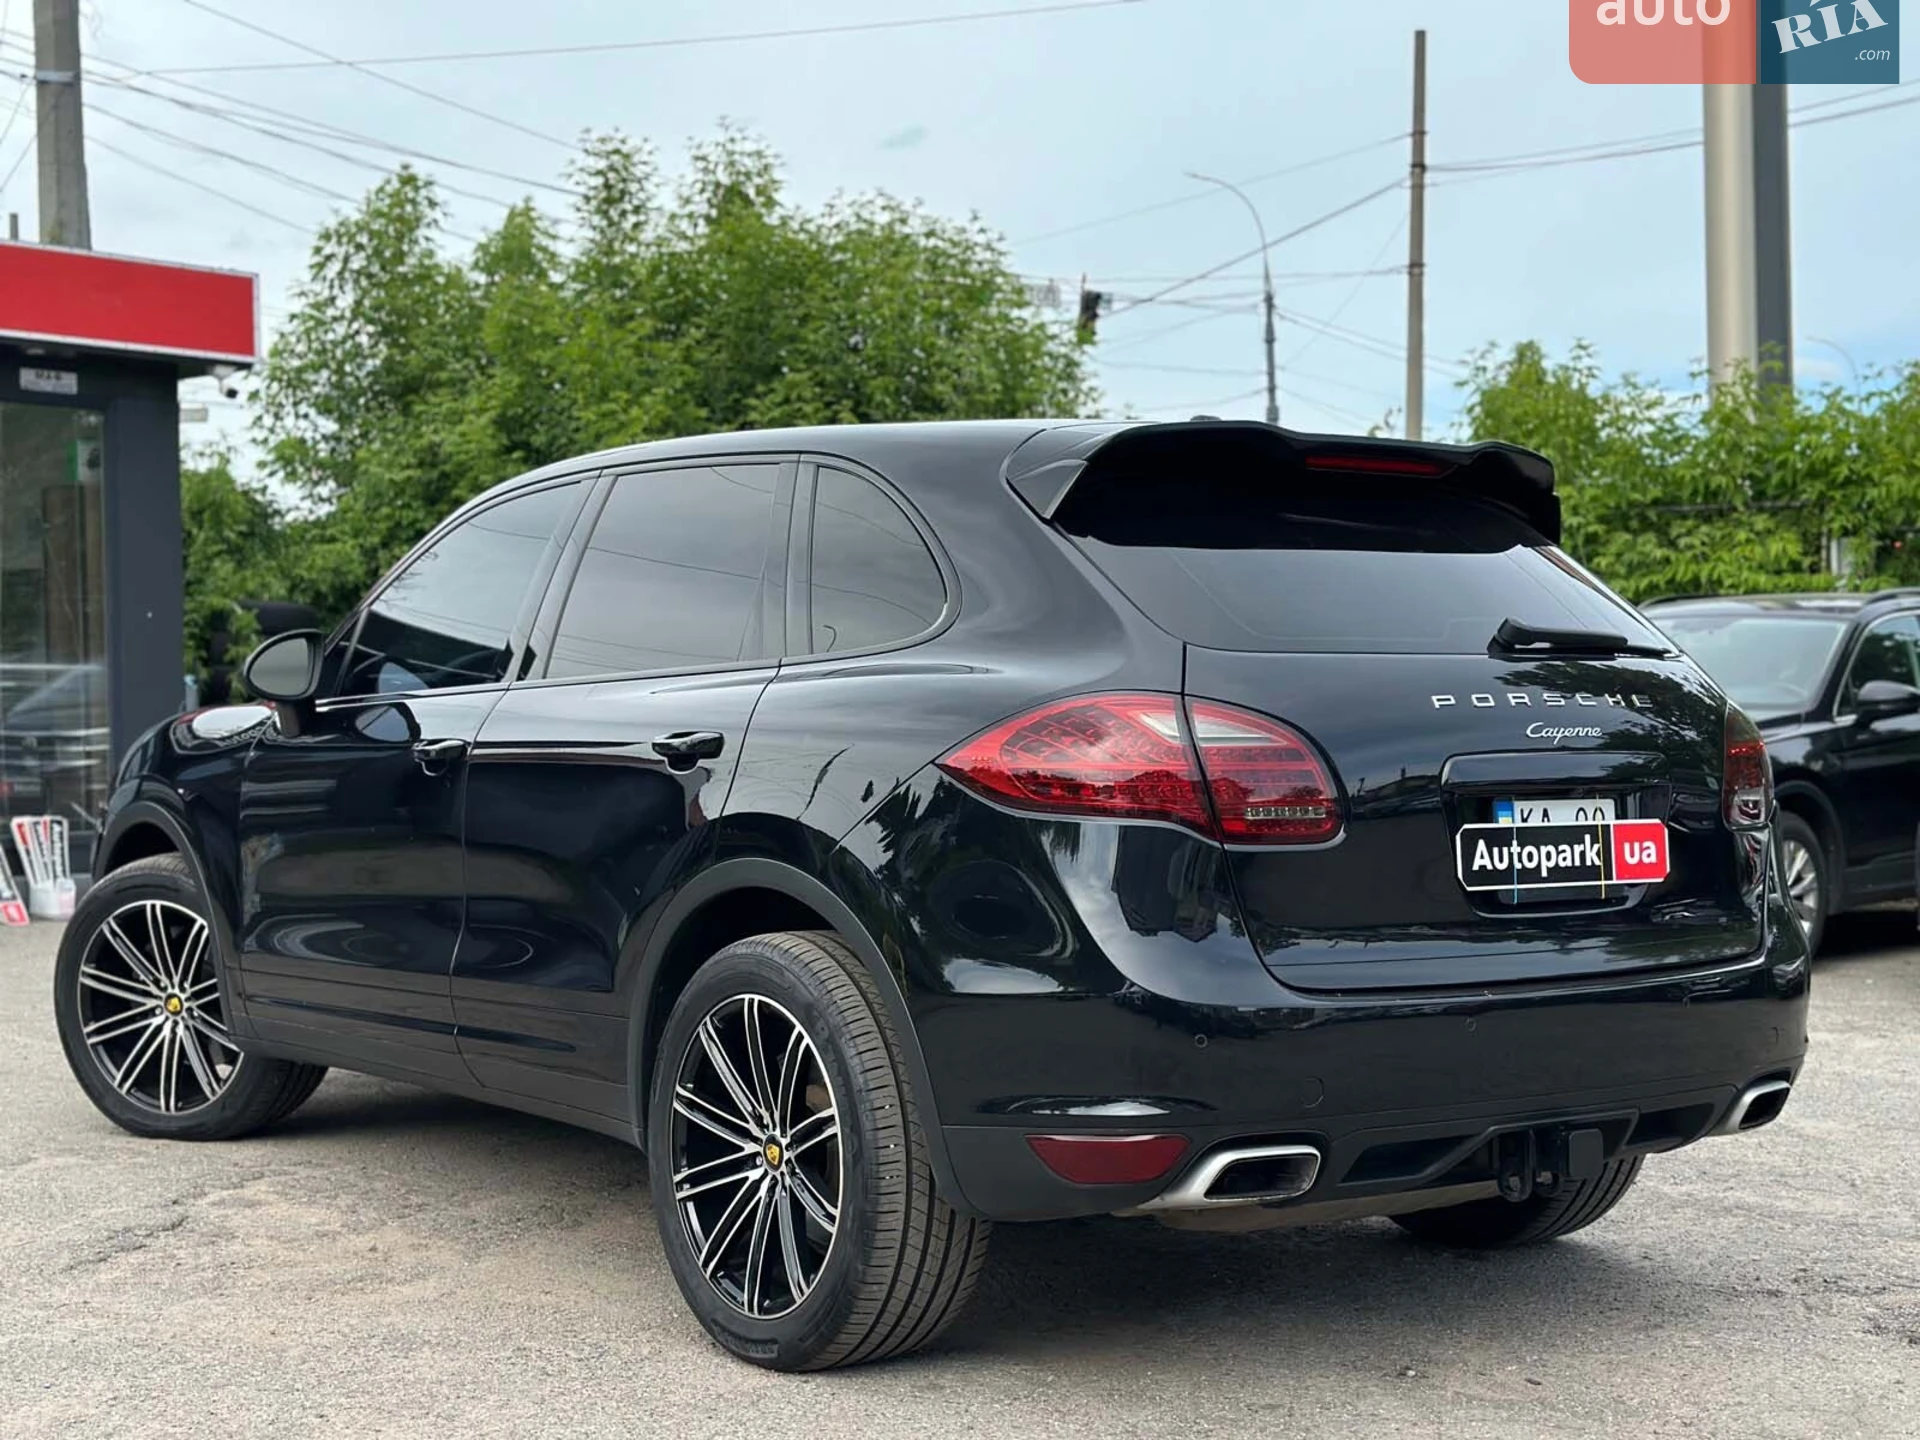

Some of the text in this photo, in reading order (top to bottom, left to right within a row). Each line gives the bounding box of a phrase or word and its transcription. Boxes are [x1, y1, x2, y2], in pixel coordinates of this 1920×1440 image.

[1431, 694, 1653, 709] PORSCHE
[1526, 722, 1602, 745] Cayenne
[1472, 835, 1657, 878] Autopark ua
